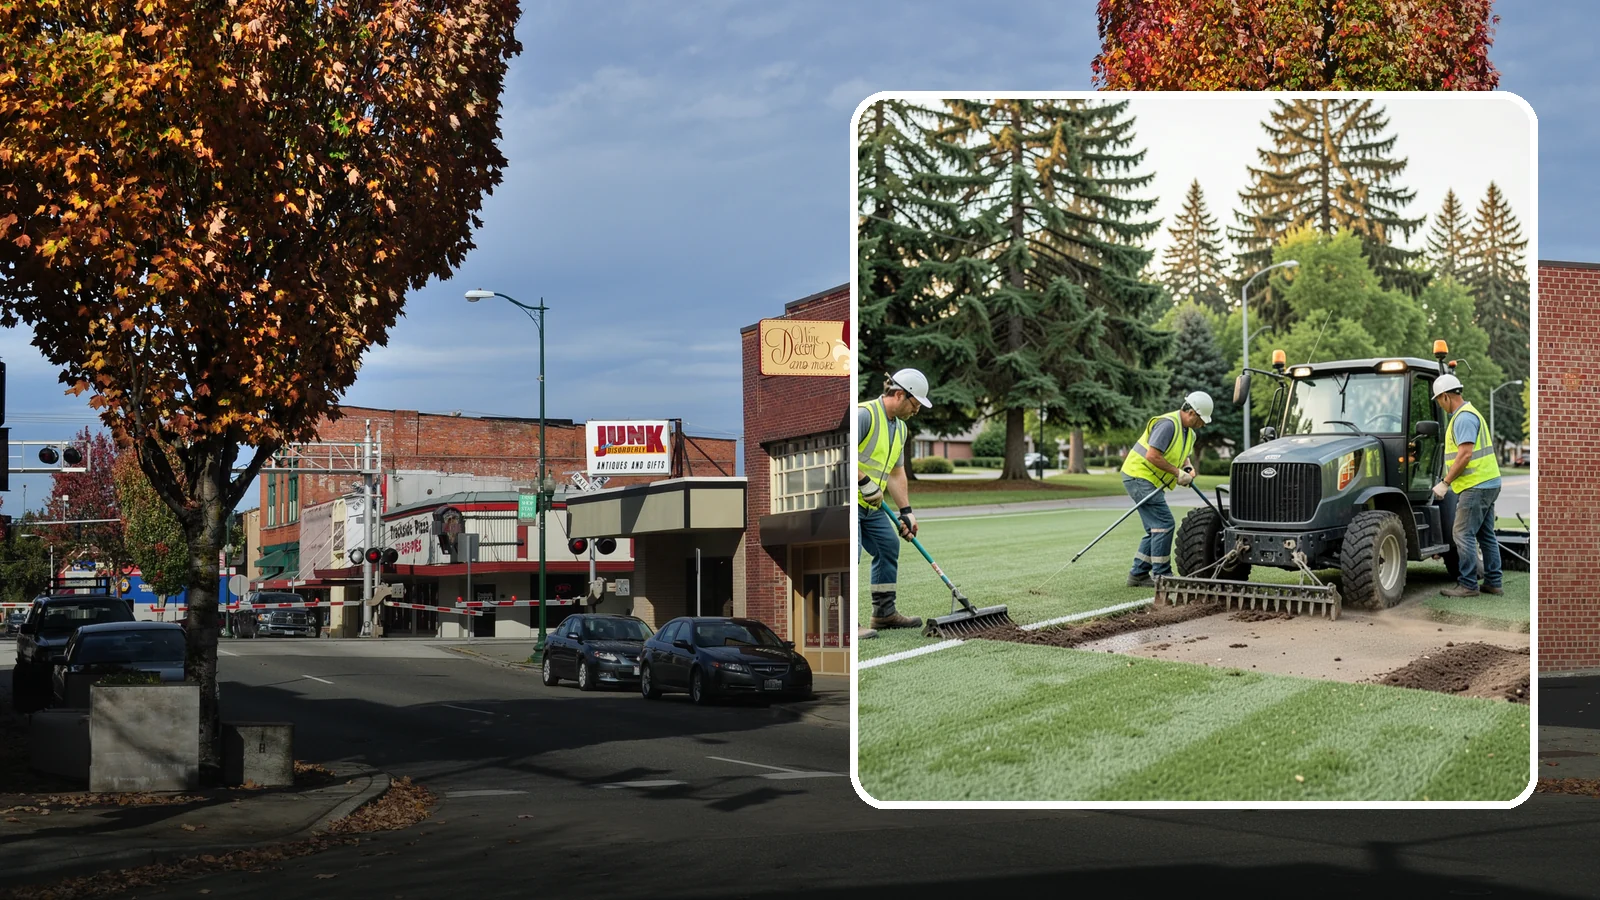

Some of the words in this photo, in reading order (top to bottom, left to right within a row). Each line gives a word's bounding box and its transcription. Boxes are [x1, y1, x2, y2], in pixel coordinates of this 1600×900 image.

[595, 425, 664, 457] JUNK
[607, 446, 646, 454] DISORDERLY
[597, 461, 628, 470] ANTIQUES
[631, 461, 644, 470] AND
[647, 460, 665, 470] GIFTS
[573, 473, 589, 491] RAIL
[390, 521, 413, 540] Trackside
[415, 519, 429, 535] Pizza
